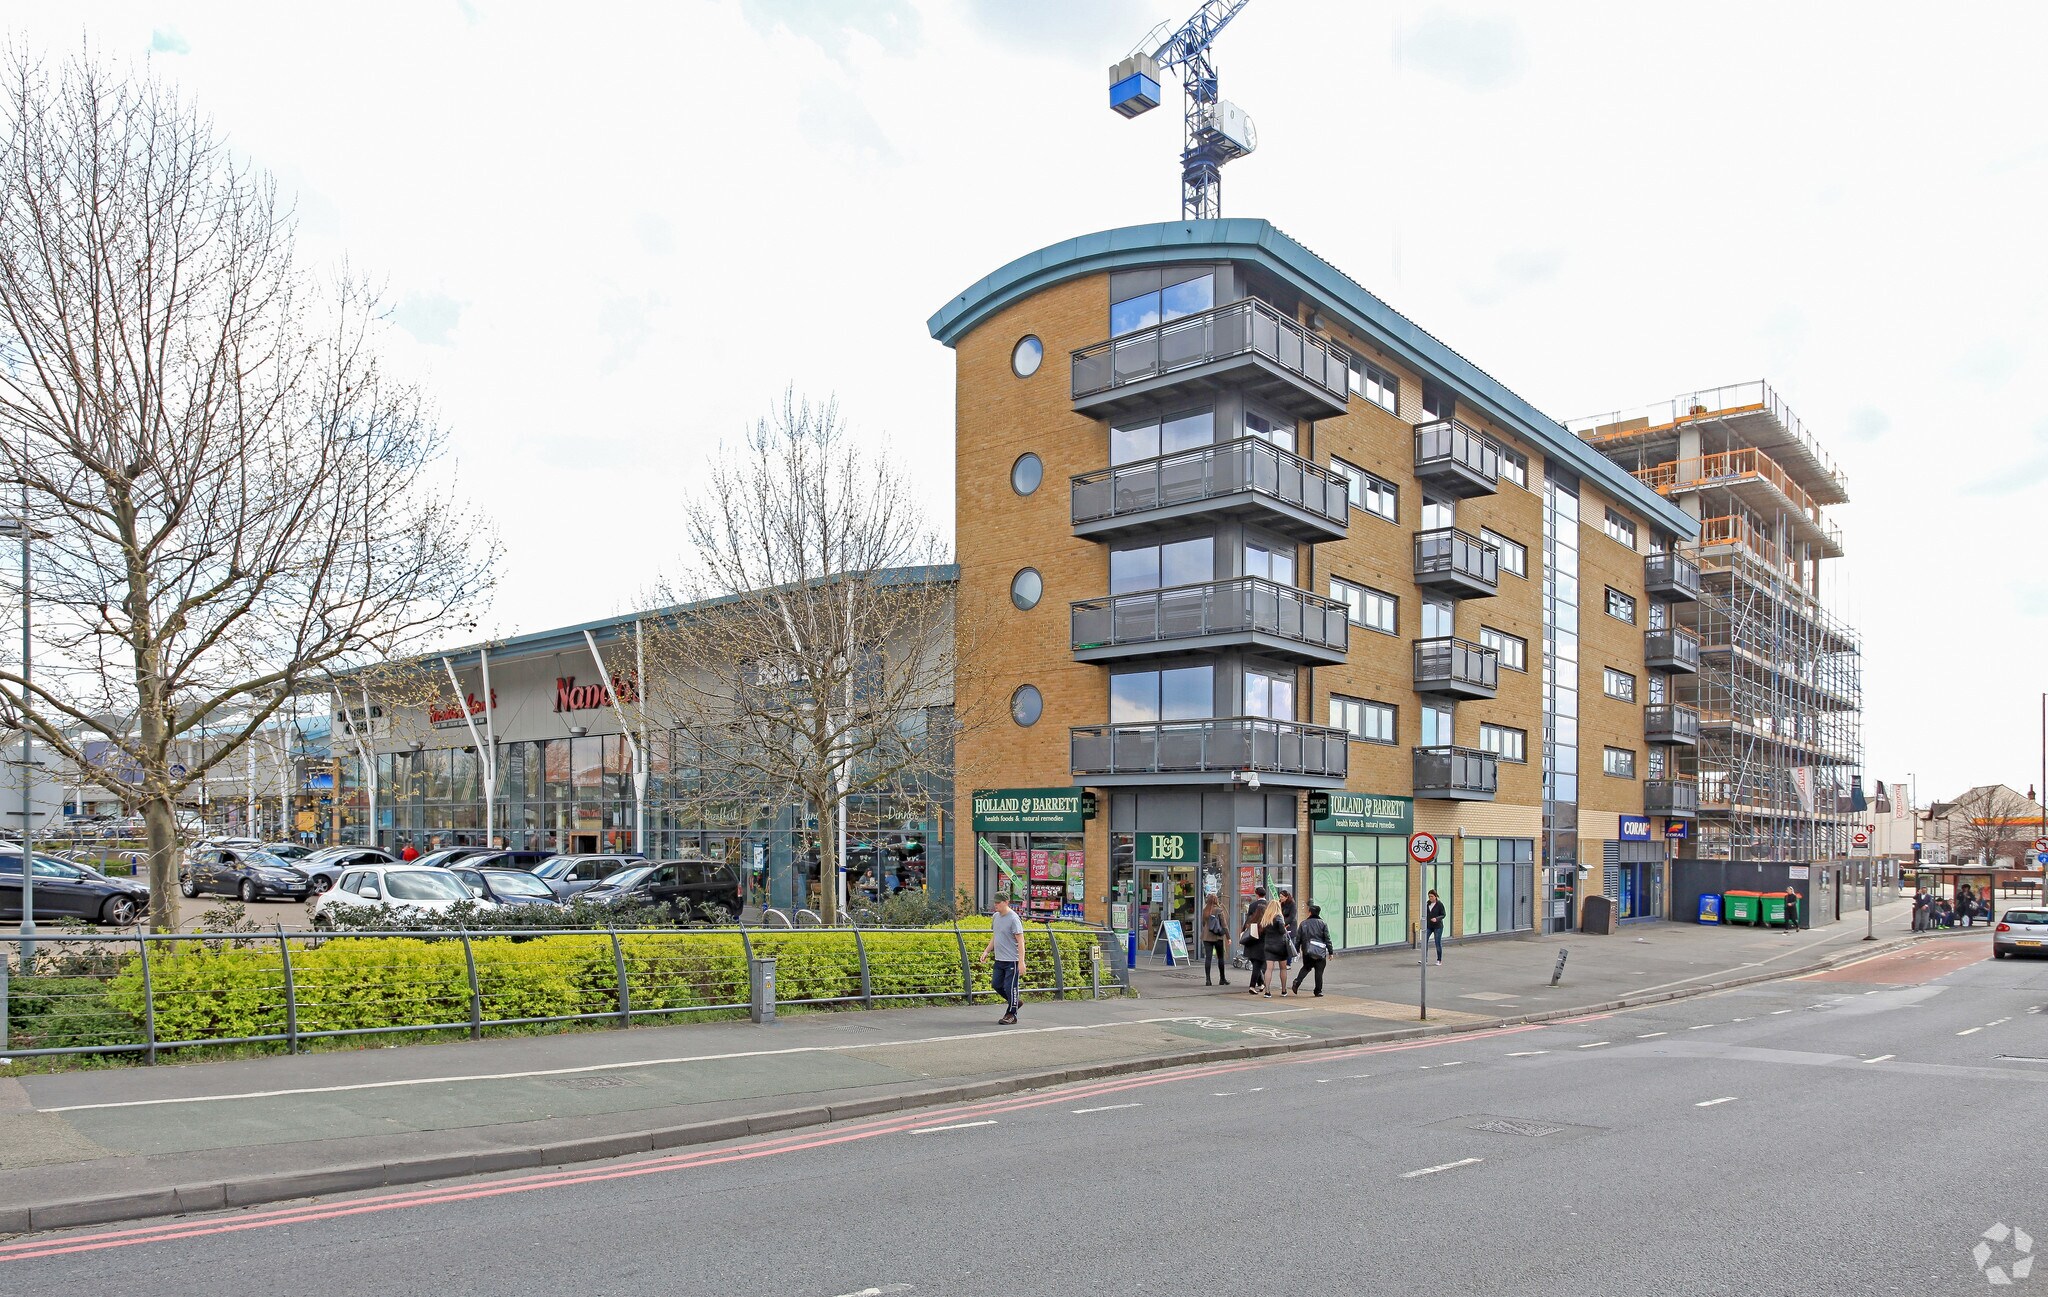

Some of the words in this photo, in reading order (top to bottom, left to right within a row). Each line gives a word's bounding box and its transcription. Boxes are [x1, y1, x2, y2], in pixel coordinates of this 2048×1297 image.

[975, 798, 1020, 814] HOLLAND
[1021, 797, 1032, 814] &
[1032, 797, 1079, 813] BARRETT
[1365, 798, 1373, 817] &
[1372, 799, 1405, 819] BARRETT
[1335, 819, 1348, 827] health
[1348, 819, 1360, 828] foods
[1365, 820, 1378, 828] natural
[1378, 821, 1395, 829] remedies
[1624, 821, 1646, 836] CORAL
[1093, 947, 1100, 959] H
